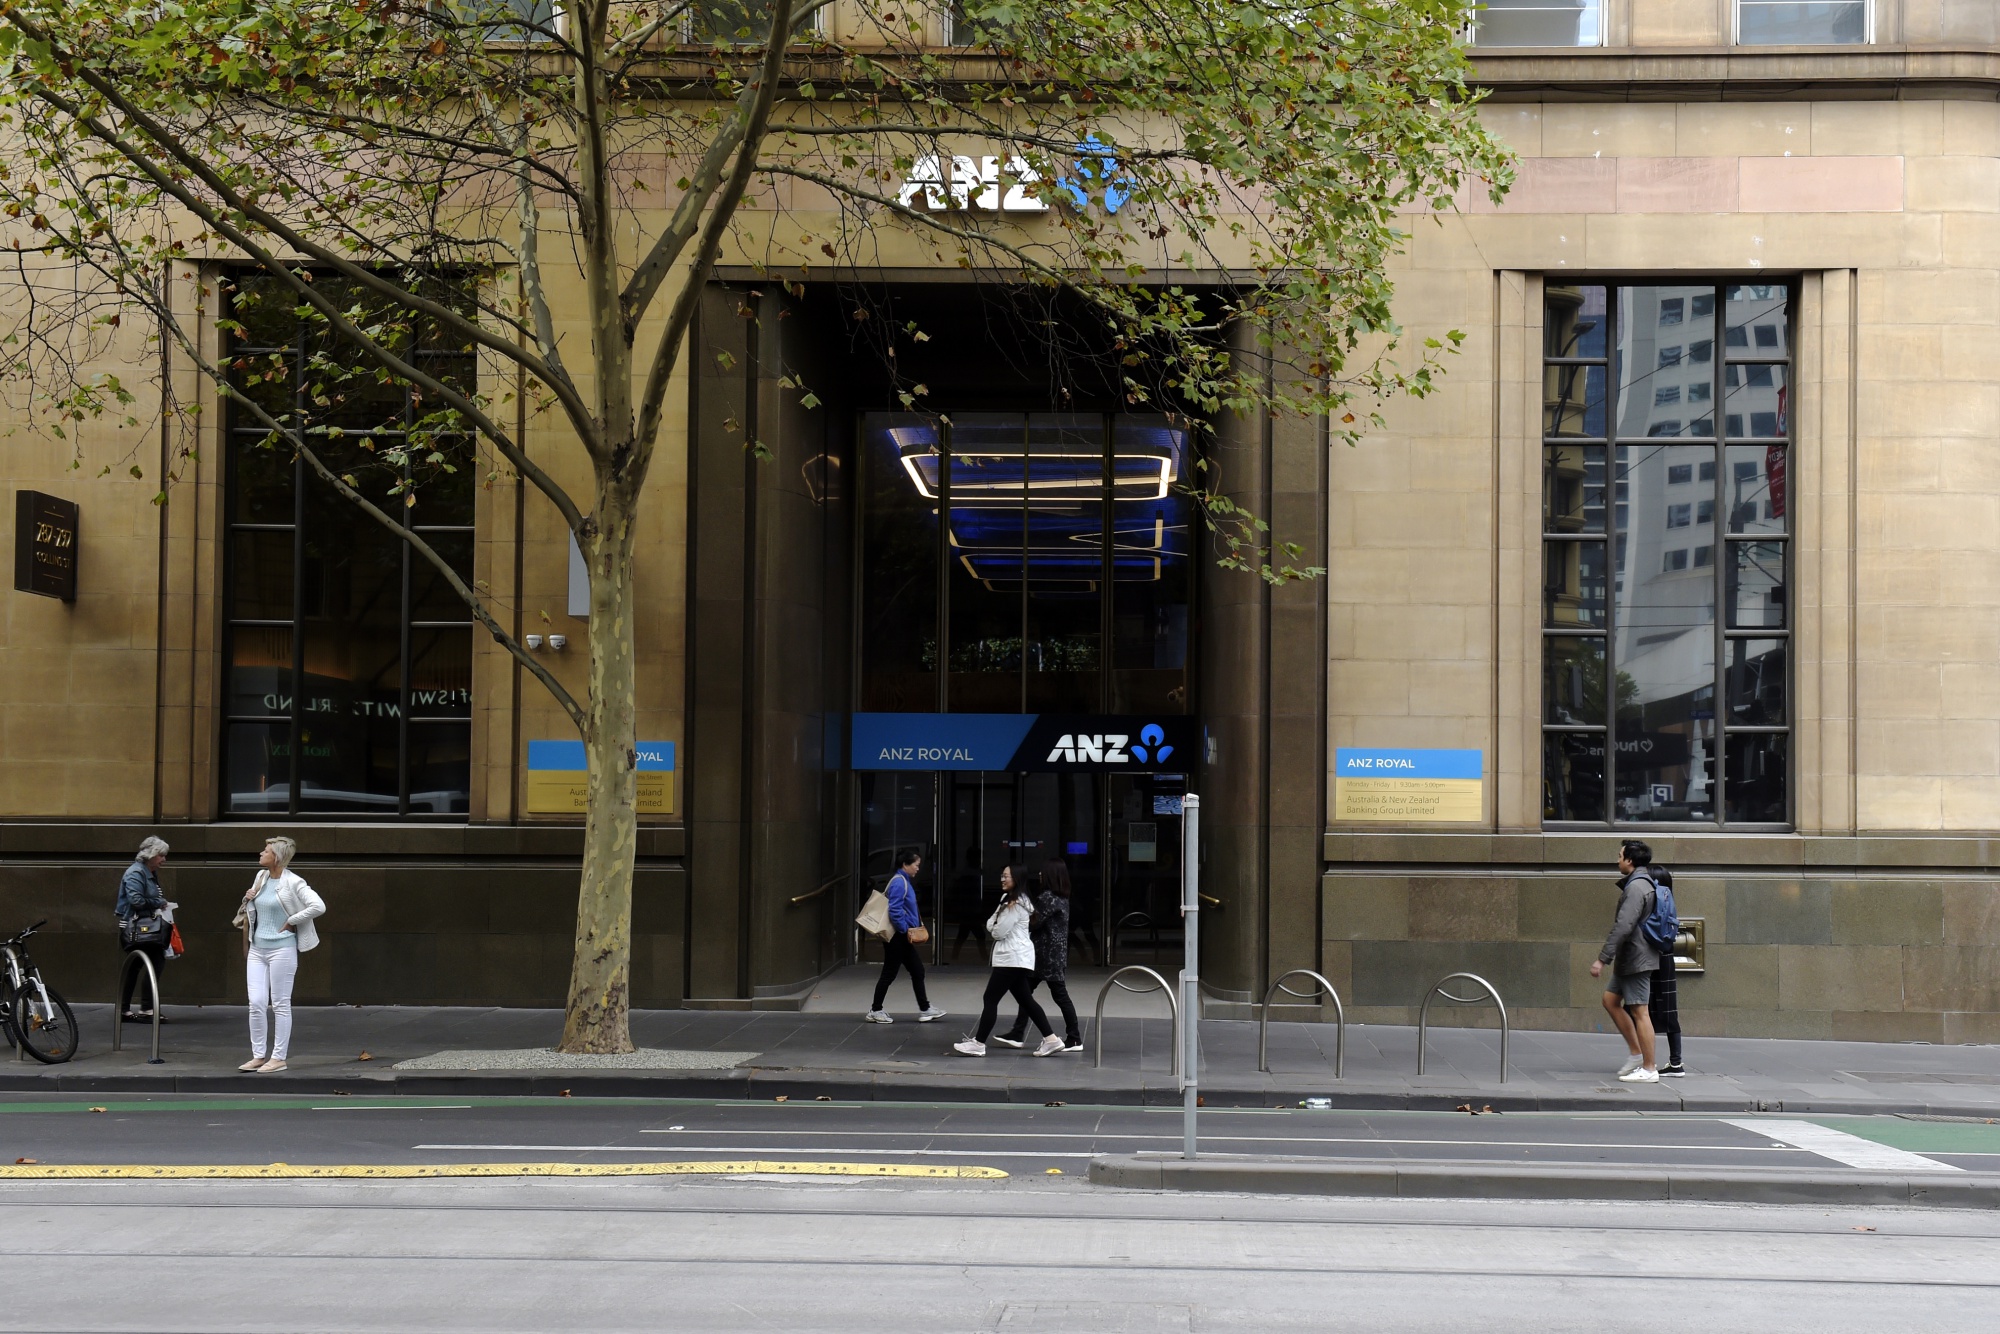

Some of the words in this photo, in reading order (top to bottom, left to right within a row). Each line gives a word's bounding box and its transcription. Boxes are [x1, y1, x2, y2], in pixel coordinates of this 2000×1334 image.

[892, 155, 1049, 211] ANZ
[1046, 734, 1129, 762] ANZ
[879, 747, 914, 761] ANZ
[918, 747, 974, 761] ROYAL
[1347, 758, 1373, 768] ANZ
[1376, 759, 1415, 769] ROYAL
[1373, 781, 1390, 789] Friday
[636, 787, 663, 797] ealand
[635, 799, 663, 808] imited
[1346, 795, 1380, 804] Australia
[1381, 796, 1388, 804] &
[1388, 796, 1407, 804] New
[1408, 796, 1440, 804] Zealand
[1346, 806, 1378, 816] Banking
[1379, 806, 1404, 816] Group
[1405, 806, 1435, 815] Limited
